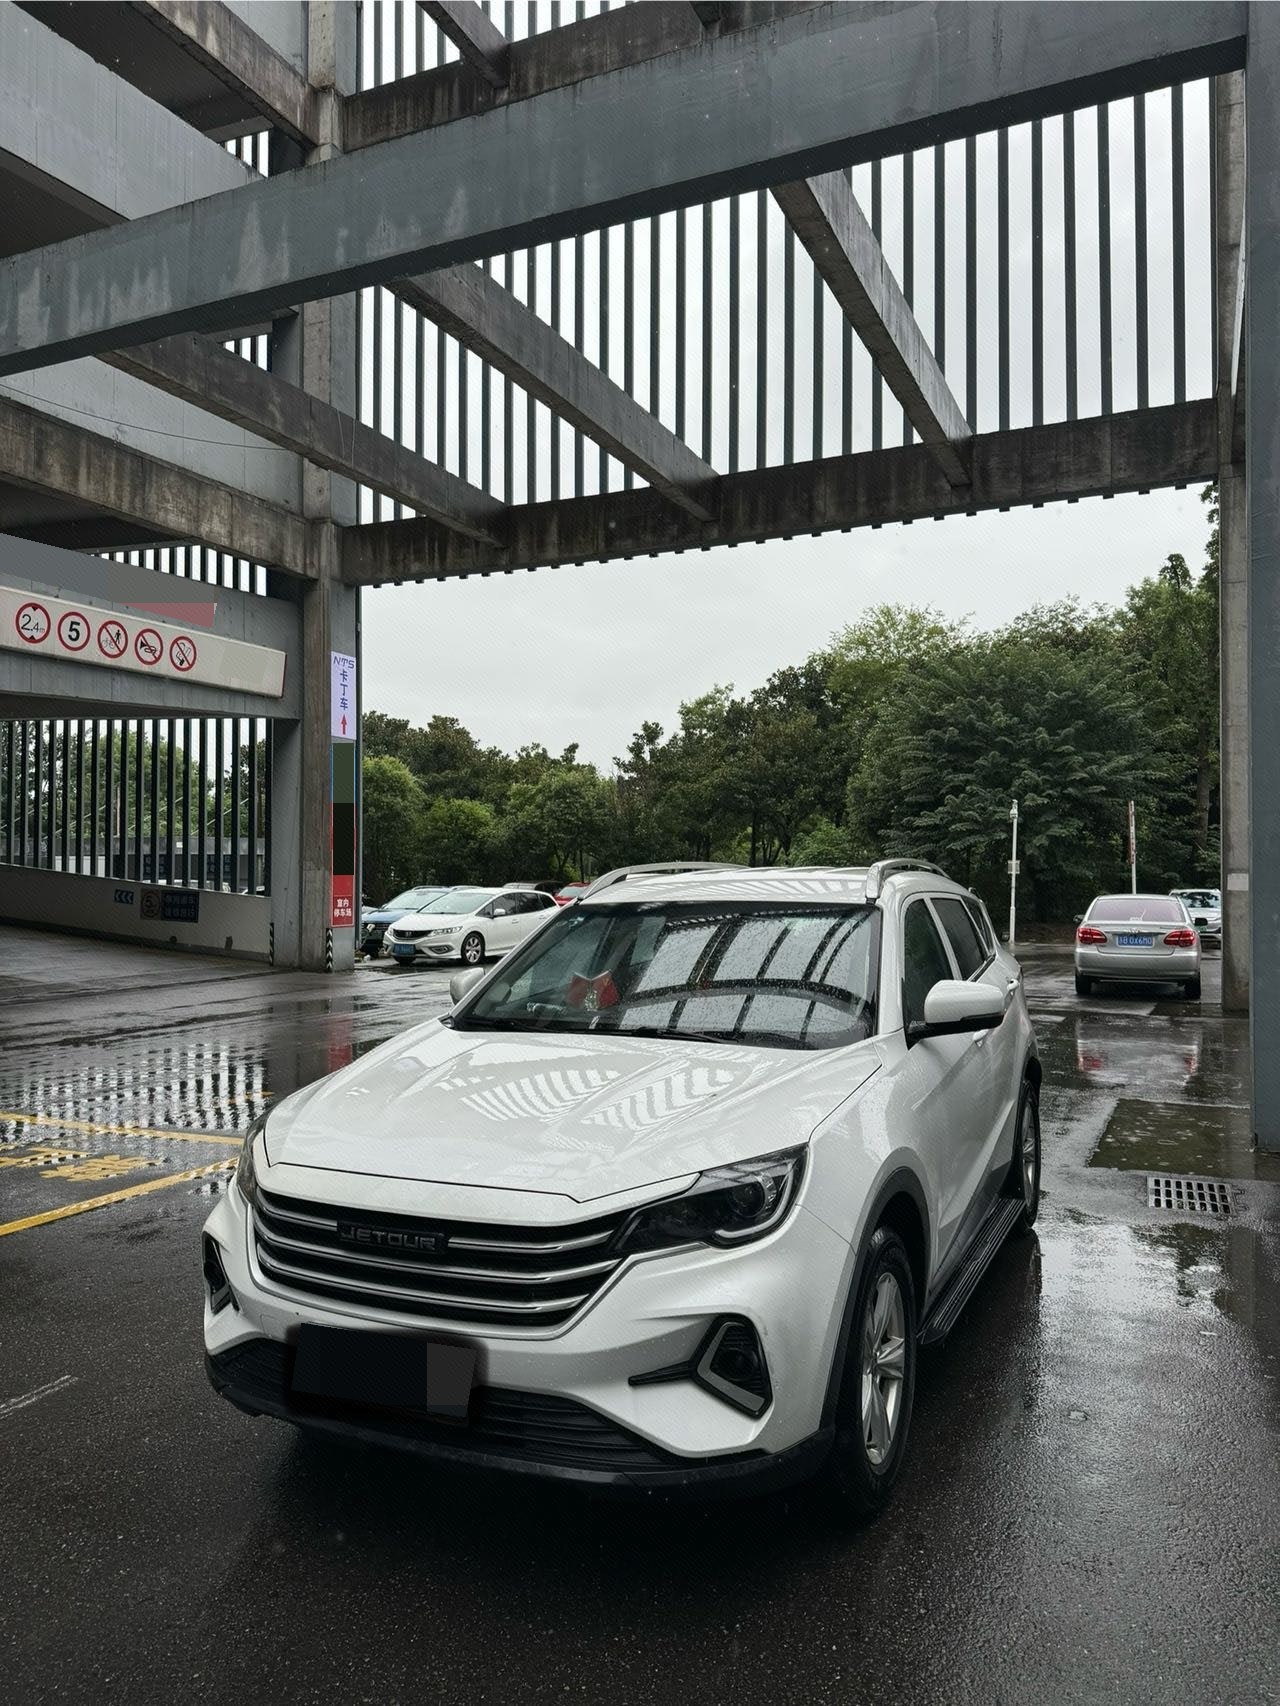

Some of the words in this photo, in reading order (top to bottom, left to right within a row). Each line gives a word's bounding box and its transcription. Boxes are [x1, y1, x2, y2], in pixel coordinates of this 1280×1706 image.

[68, 620, 81, 642] 5
[333, 655, 355, 669] NTS
[339, 668, 349, 711] 卡丁车
[341, 1226, 435, 1251] JETOUR
